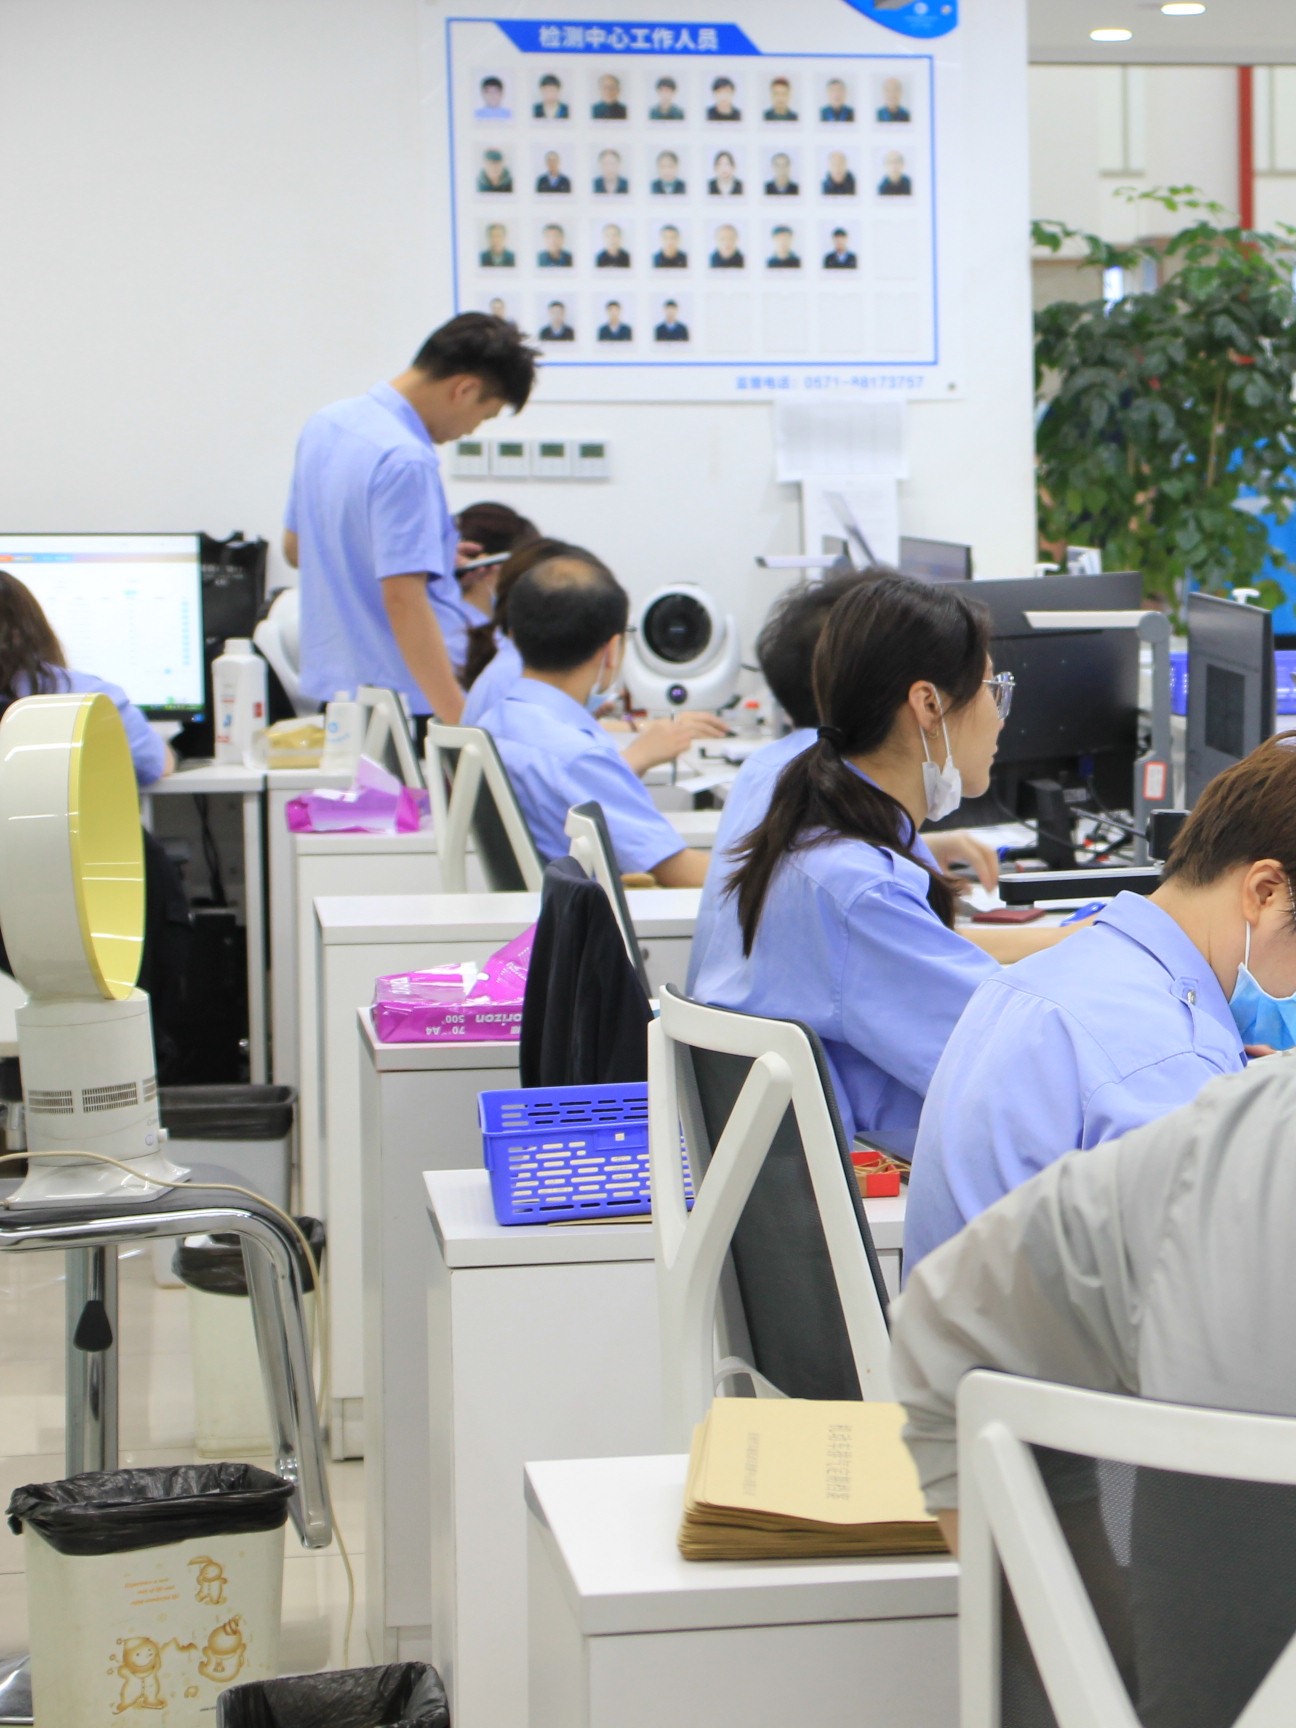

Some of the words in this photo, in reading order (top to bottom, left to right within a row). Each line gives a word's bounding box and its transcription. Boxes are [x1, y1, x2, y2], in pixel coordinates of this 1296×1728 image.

[539, 25, 719, 51] 检测中心工作人员
[446, 1014, 465, 1024] 500
[475, 1013, 523, 1027] orizon
[425, 1026, 441, 1035] A4
